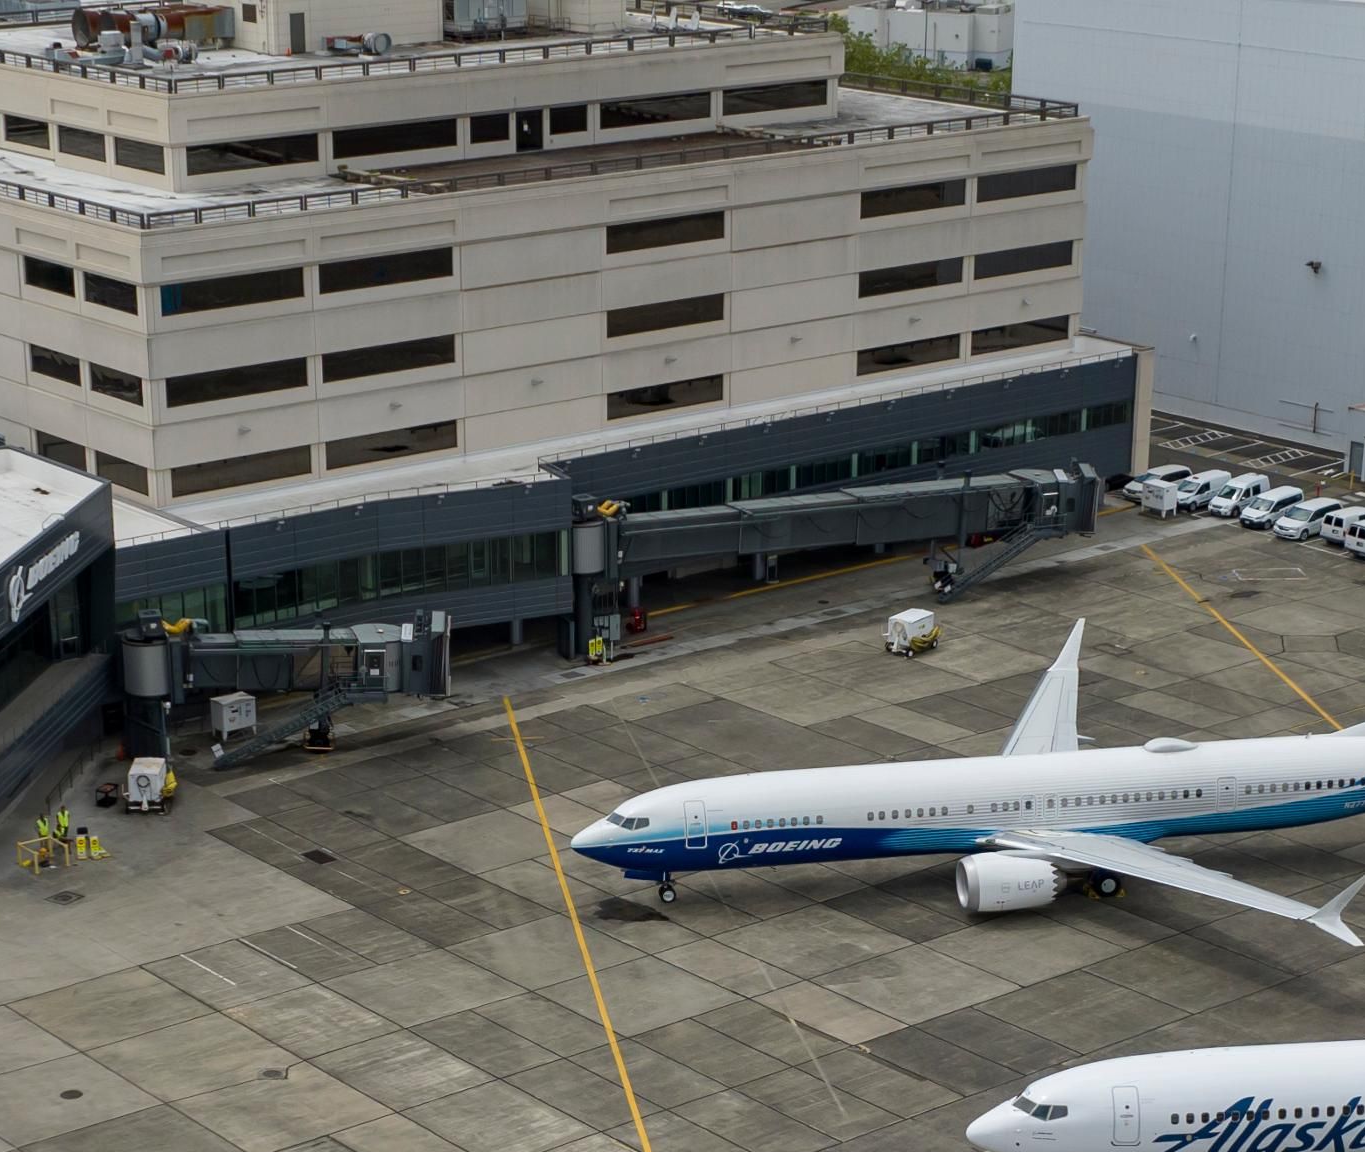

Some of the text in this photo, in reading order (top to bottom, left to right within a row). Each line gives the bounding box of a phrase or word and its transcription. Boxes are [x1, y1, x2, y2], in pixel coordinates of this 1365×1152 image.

[26, 531, 80, 590] BOEING
[748, 838, 843, 855] BOEING
[1018, 879, 1045, 891] LEAP
